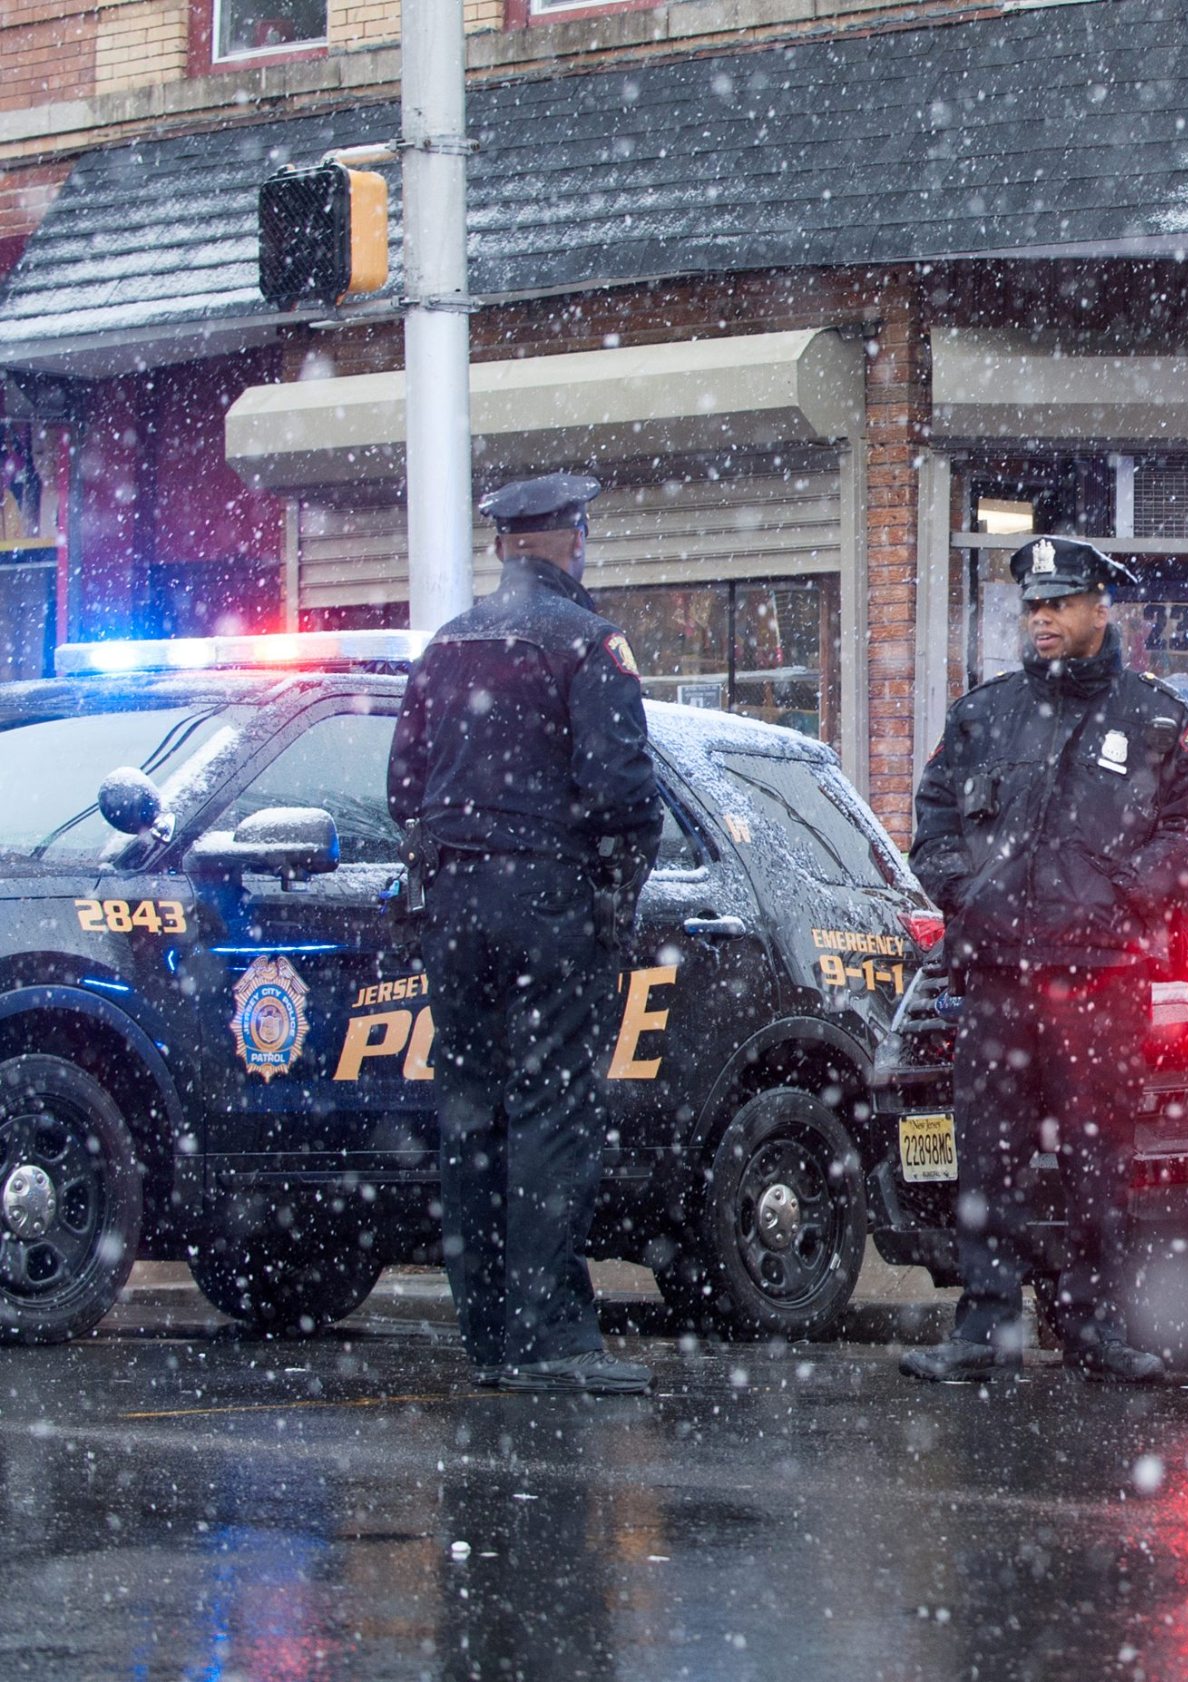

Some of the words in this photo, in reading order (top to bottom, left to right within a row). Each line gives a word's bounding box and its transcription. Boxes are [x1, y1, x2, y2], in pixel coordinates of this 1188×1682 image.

[75, 900, 187, 934] 2843
[811, 928, 905, 957] EMERGENCY
[351, 973, 429, 1008] JERSEY
[819, 955, 905, 995] 9-1-1
[242, 993, 260, 1036] JERSEY
[261, 988, 282, 999] CITY
[282, 996, 297, 1038] POLICE
[250, 1052, 286, 1064] PATROL
[904, 1133, 953, 1166] 22898MG
